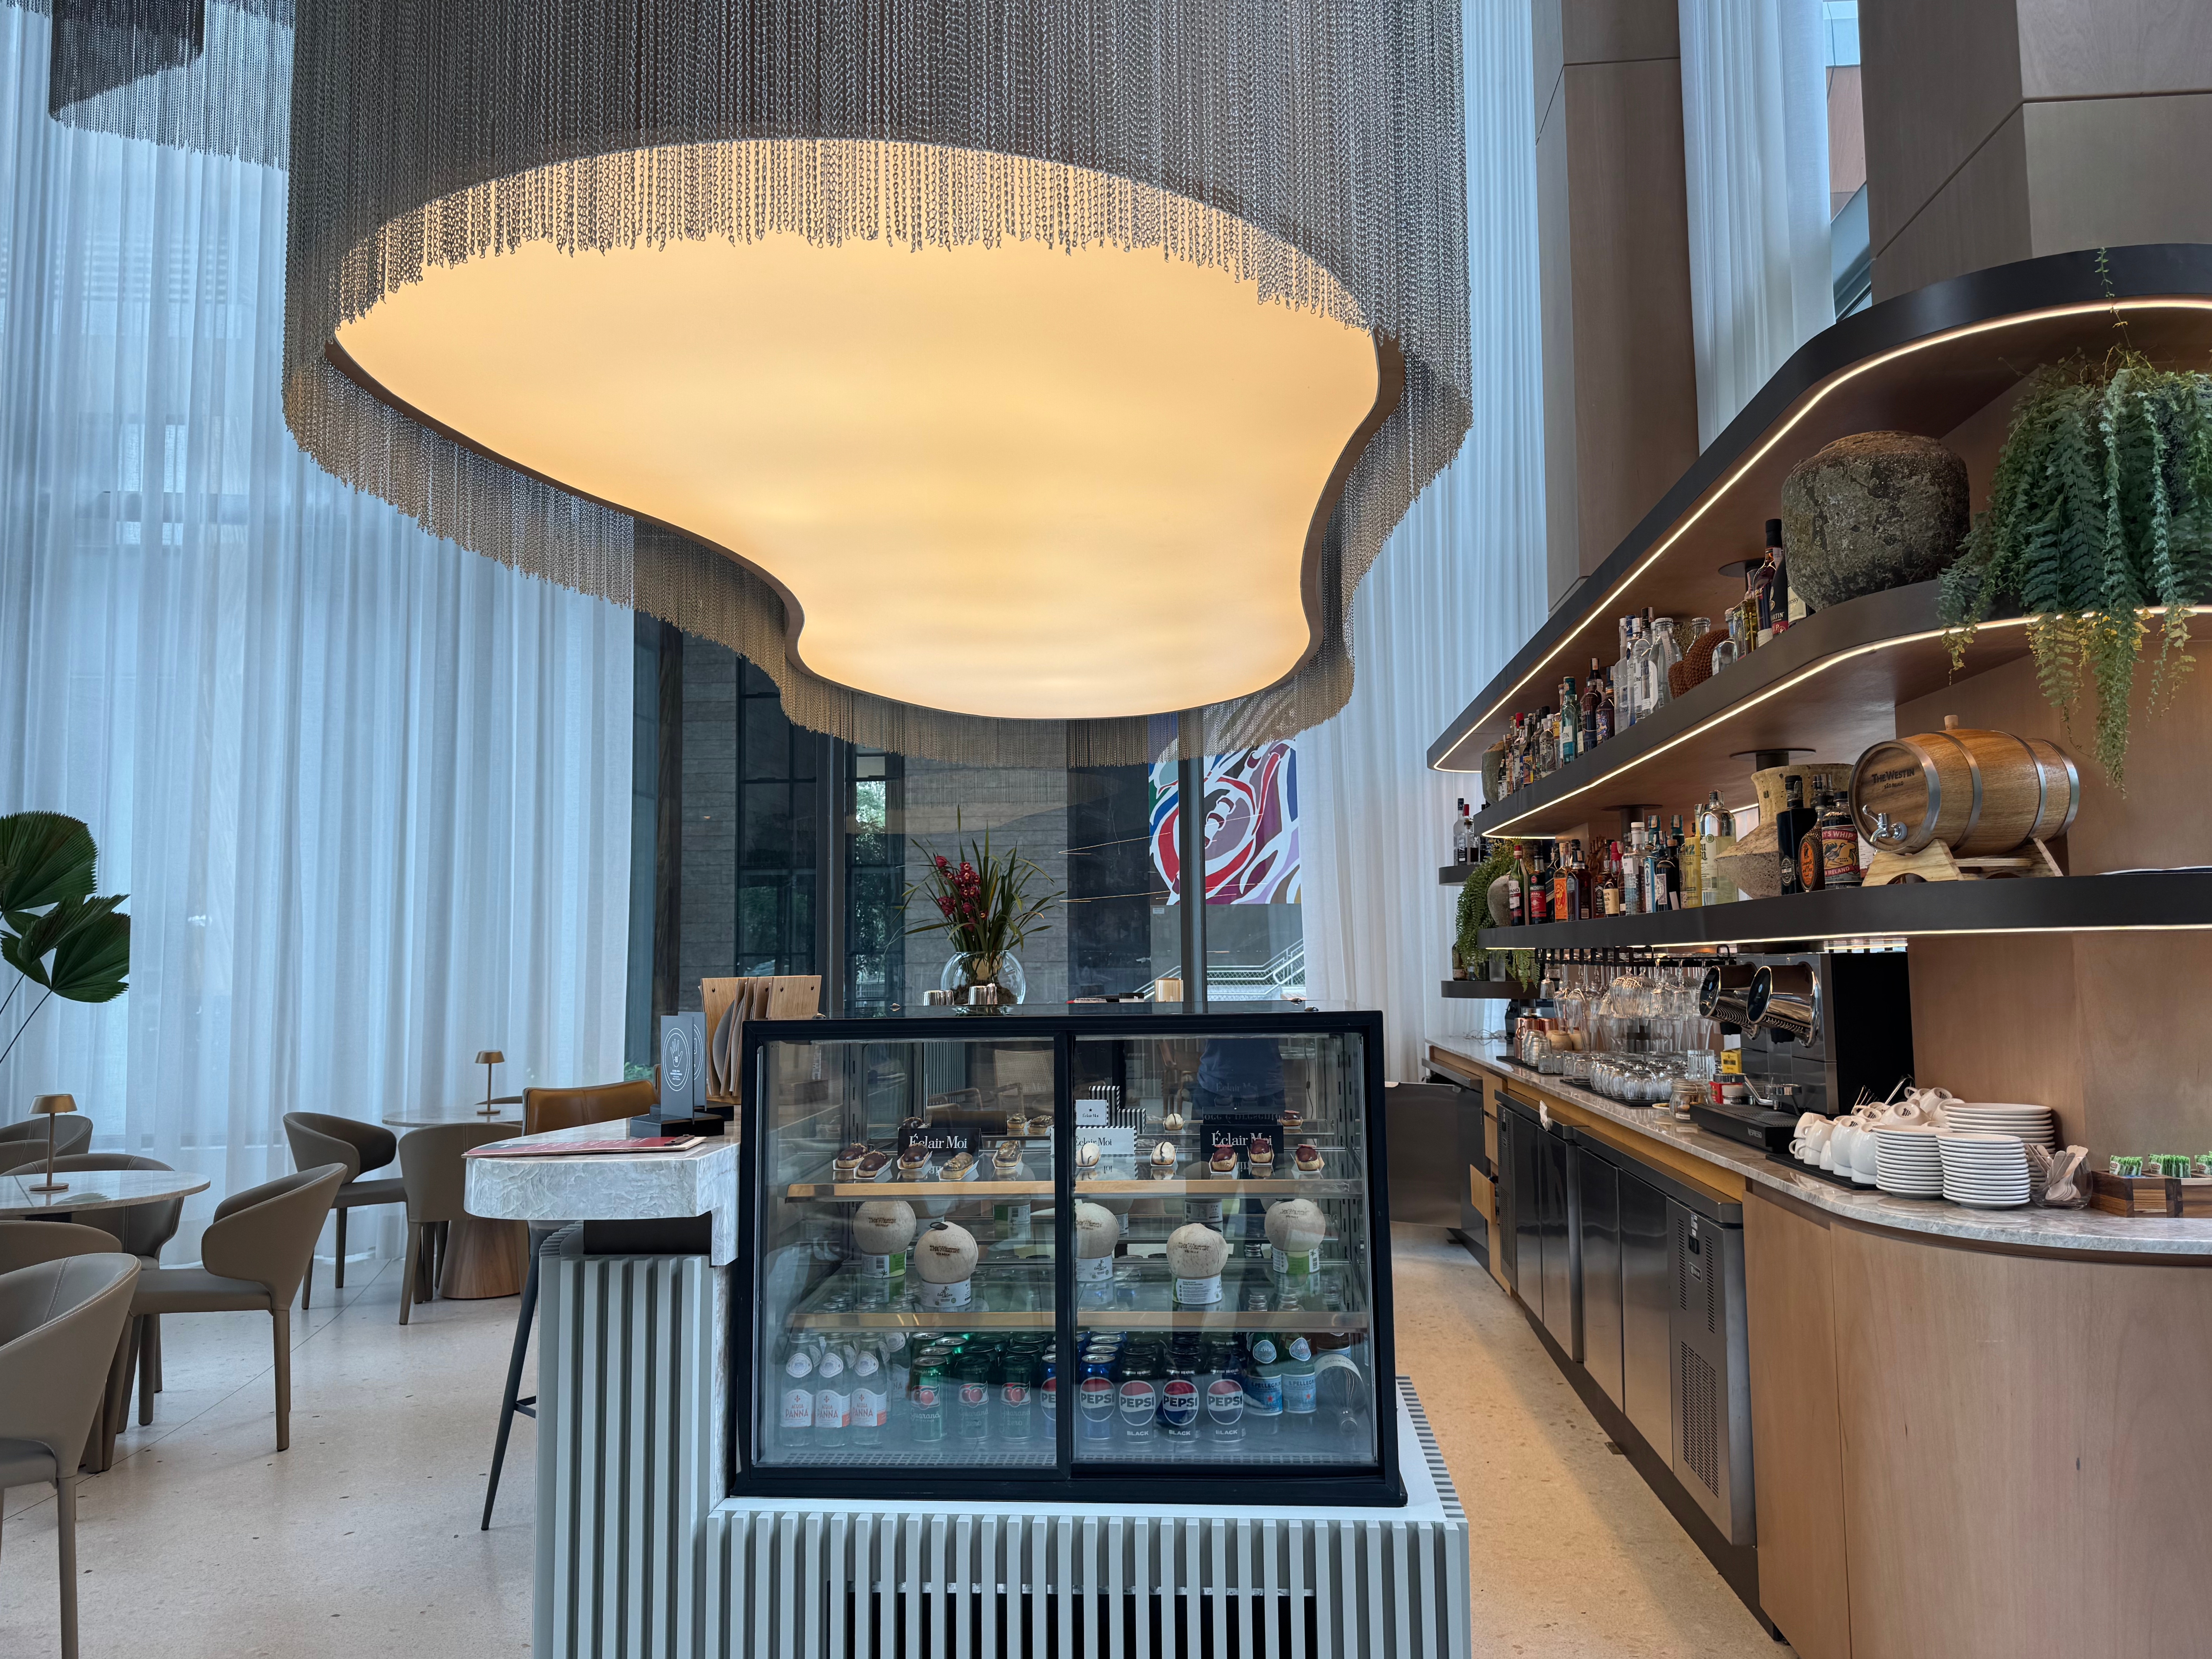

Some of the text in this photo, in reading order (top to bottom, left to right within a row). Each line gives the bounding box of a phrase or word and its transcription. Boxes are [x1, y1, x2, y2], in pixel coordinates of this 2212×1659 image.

[1885, 768, 1915, 780] WESTIN
[1832, 831, 1853, 839] WHIP
[1827, 866, 1850, 875] IRELAND
[946, 1135, 967, 1149] Moi
[1098, 1137, 1112, 1146] Moi
[1211, 1130, 1248, 1146] Éclair
[1081, 1393, 1114, 1404] PEPSI
[1120, 1396, 1154, 1408] PEPSI
[1163, 1395, 1197, 1407] PEPSI
[1208, 1395, 1242, 1407] PEPSI
[785, 1408, 809, 1418] PANNA
[817, 1409, 838, 1419] PANNA
[852, 1408, 873, 1417] PANNA
[910, 1408, 941, 1421] Guaraná
